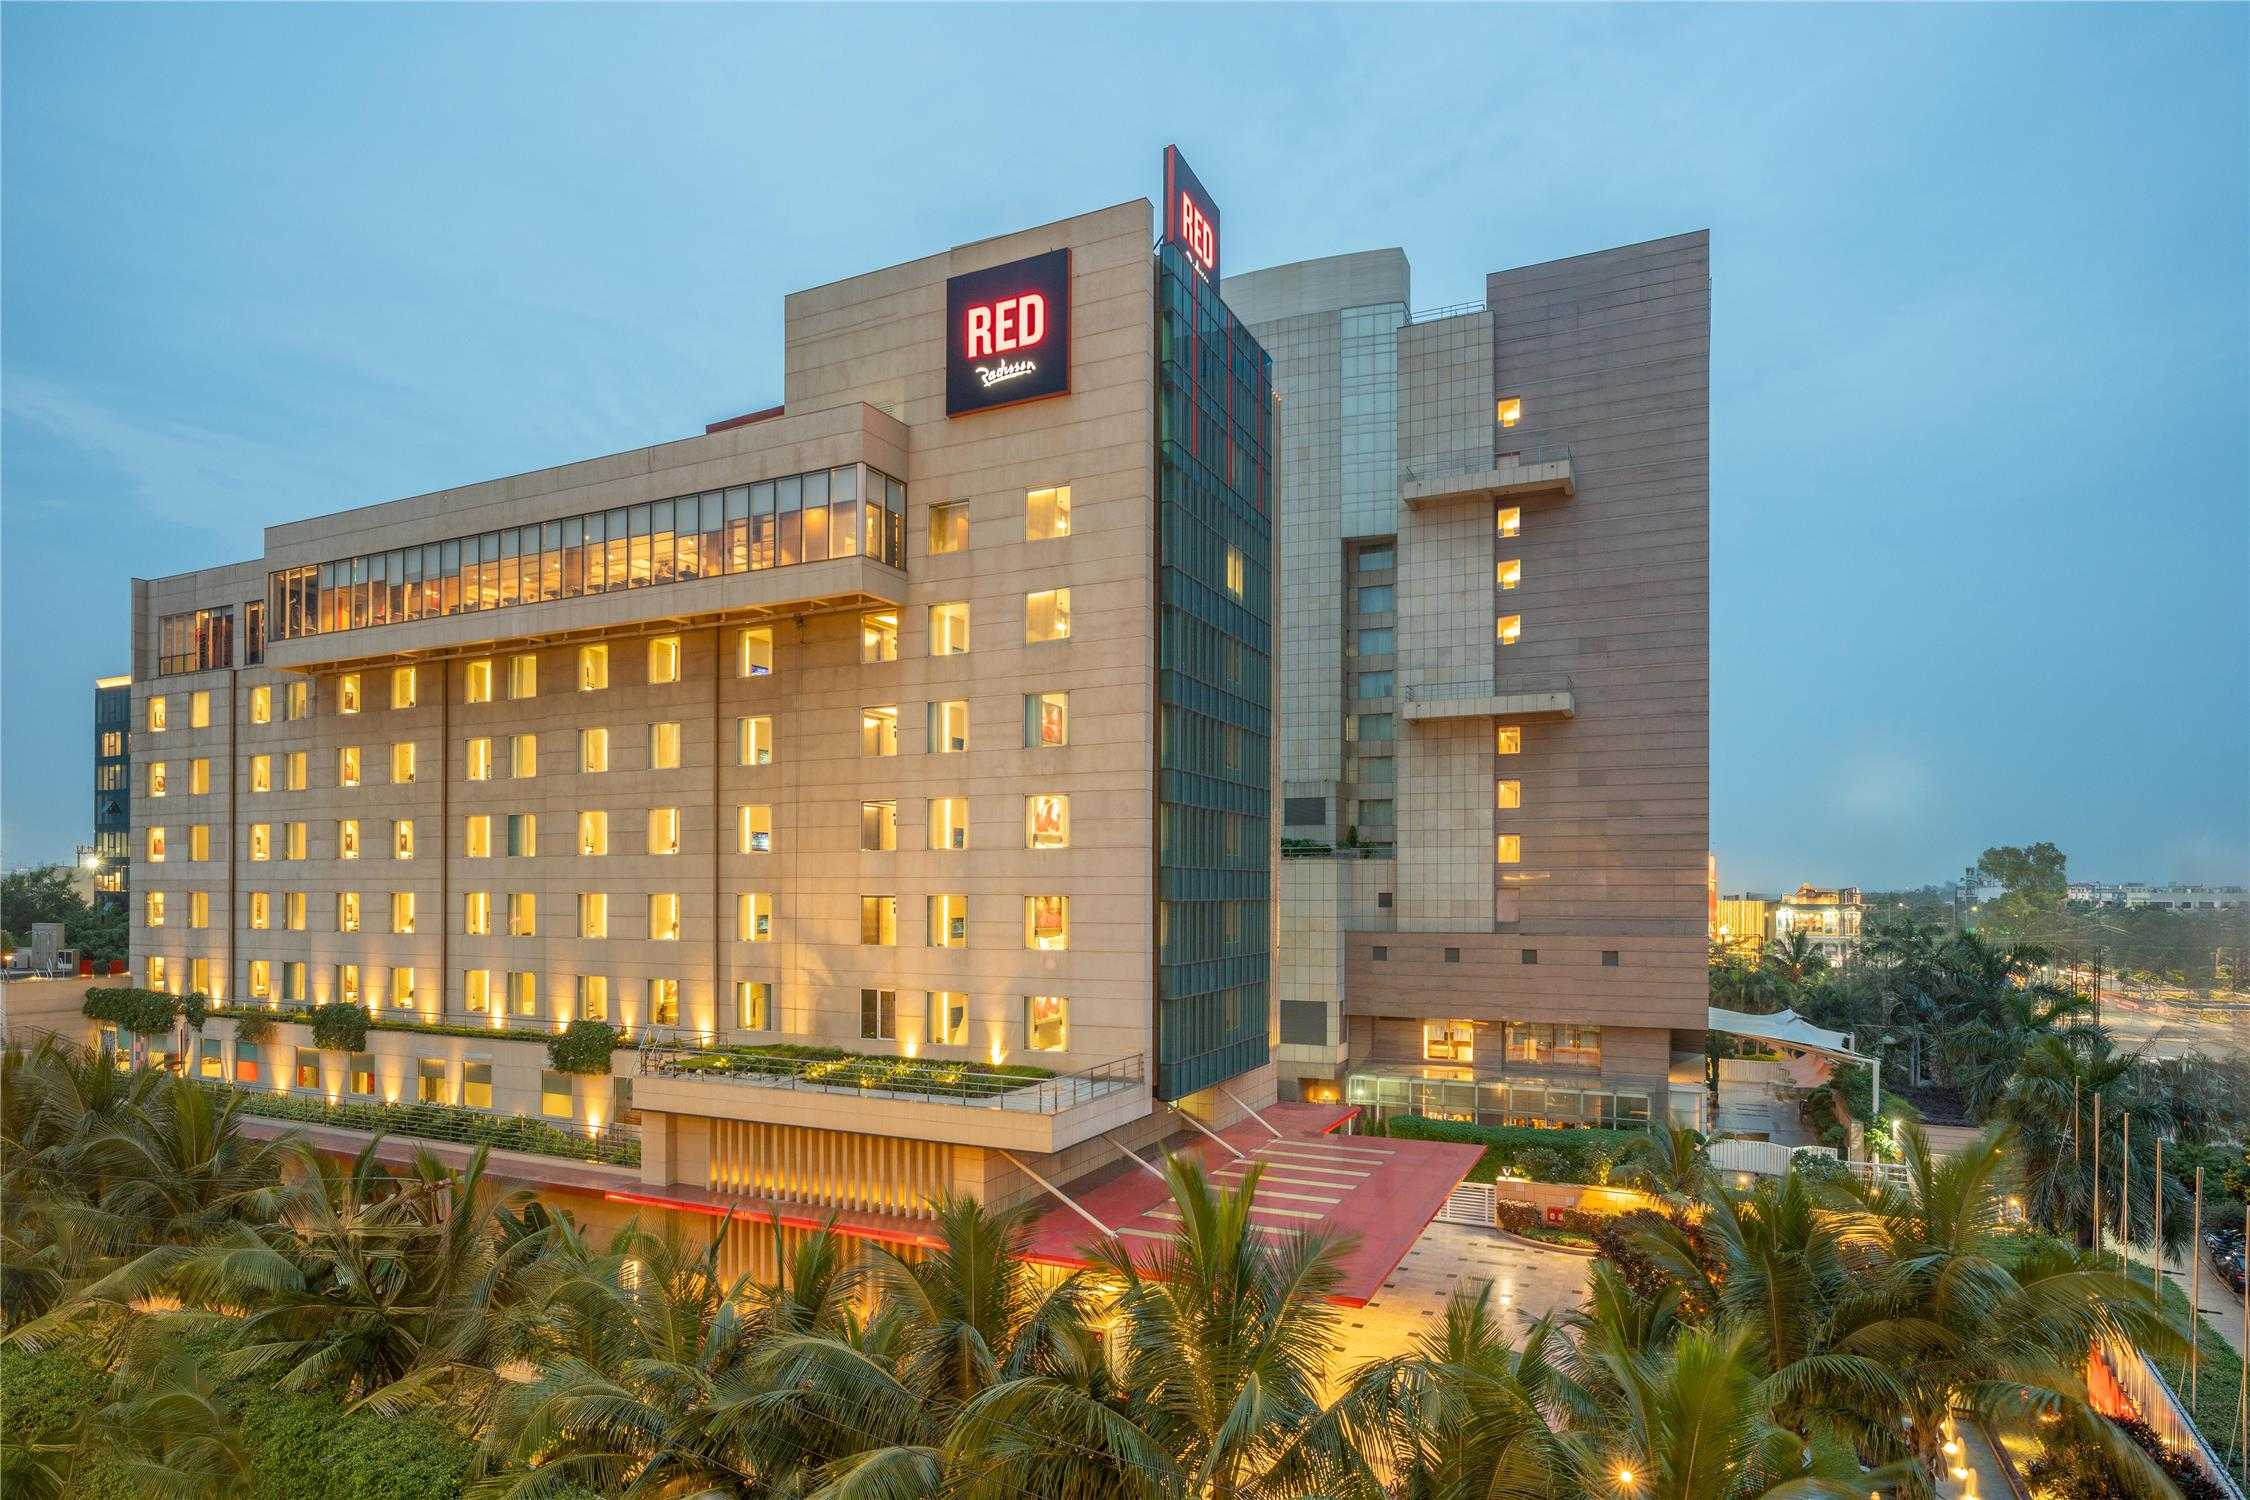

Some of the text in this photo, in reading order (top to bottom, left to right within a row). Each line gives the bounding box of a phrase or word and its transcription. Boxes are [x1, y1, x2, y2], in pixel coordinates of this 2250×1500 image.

[1183, 191, 1213, 269] RED
[967, 293, 1045, 359] RED
[975, 358, 1037, 387] Radisson
